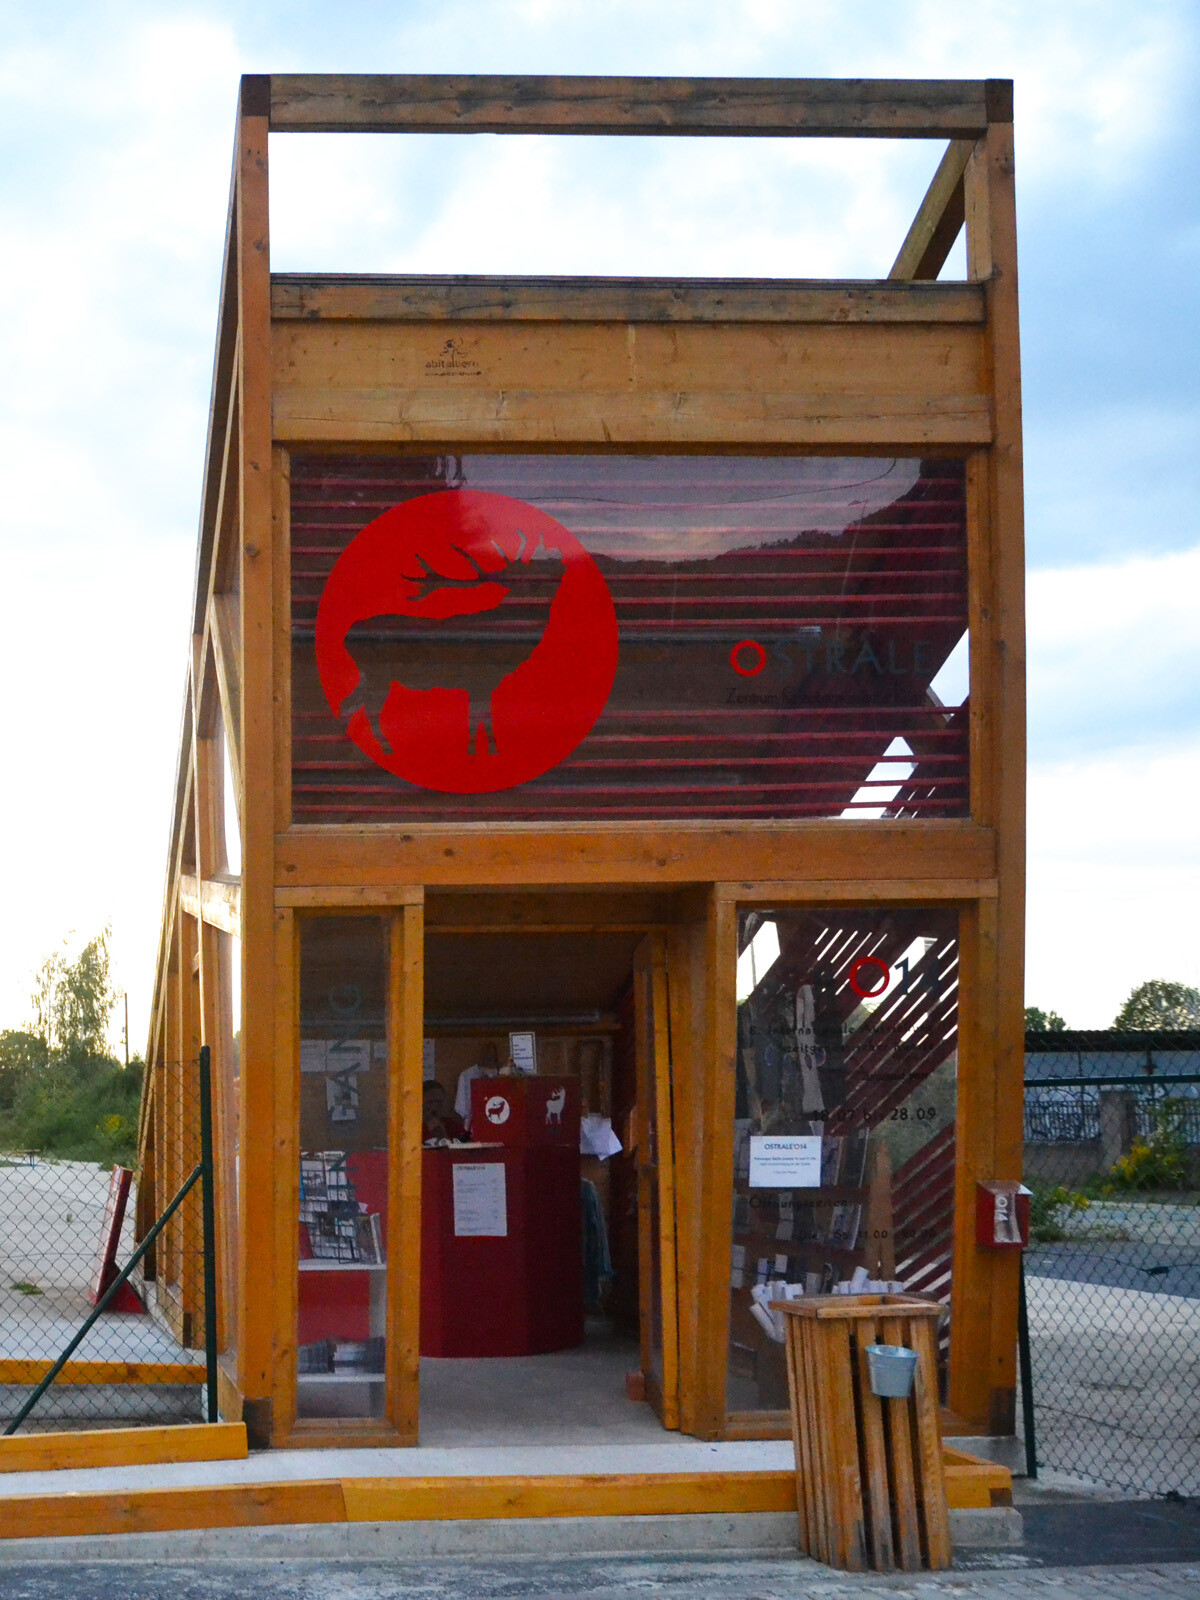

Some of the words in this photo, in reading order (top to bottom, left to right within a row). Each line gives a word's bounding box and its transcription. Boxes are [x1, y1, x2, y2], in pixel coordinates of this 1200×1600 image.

[729, 638, 932, 677] OSTRALE
[768, 1022, 855, 1035] Internatnale
[890, 1107, 936, 1121] 28.09
